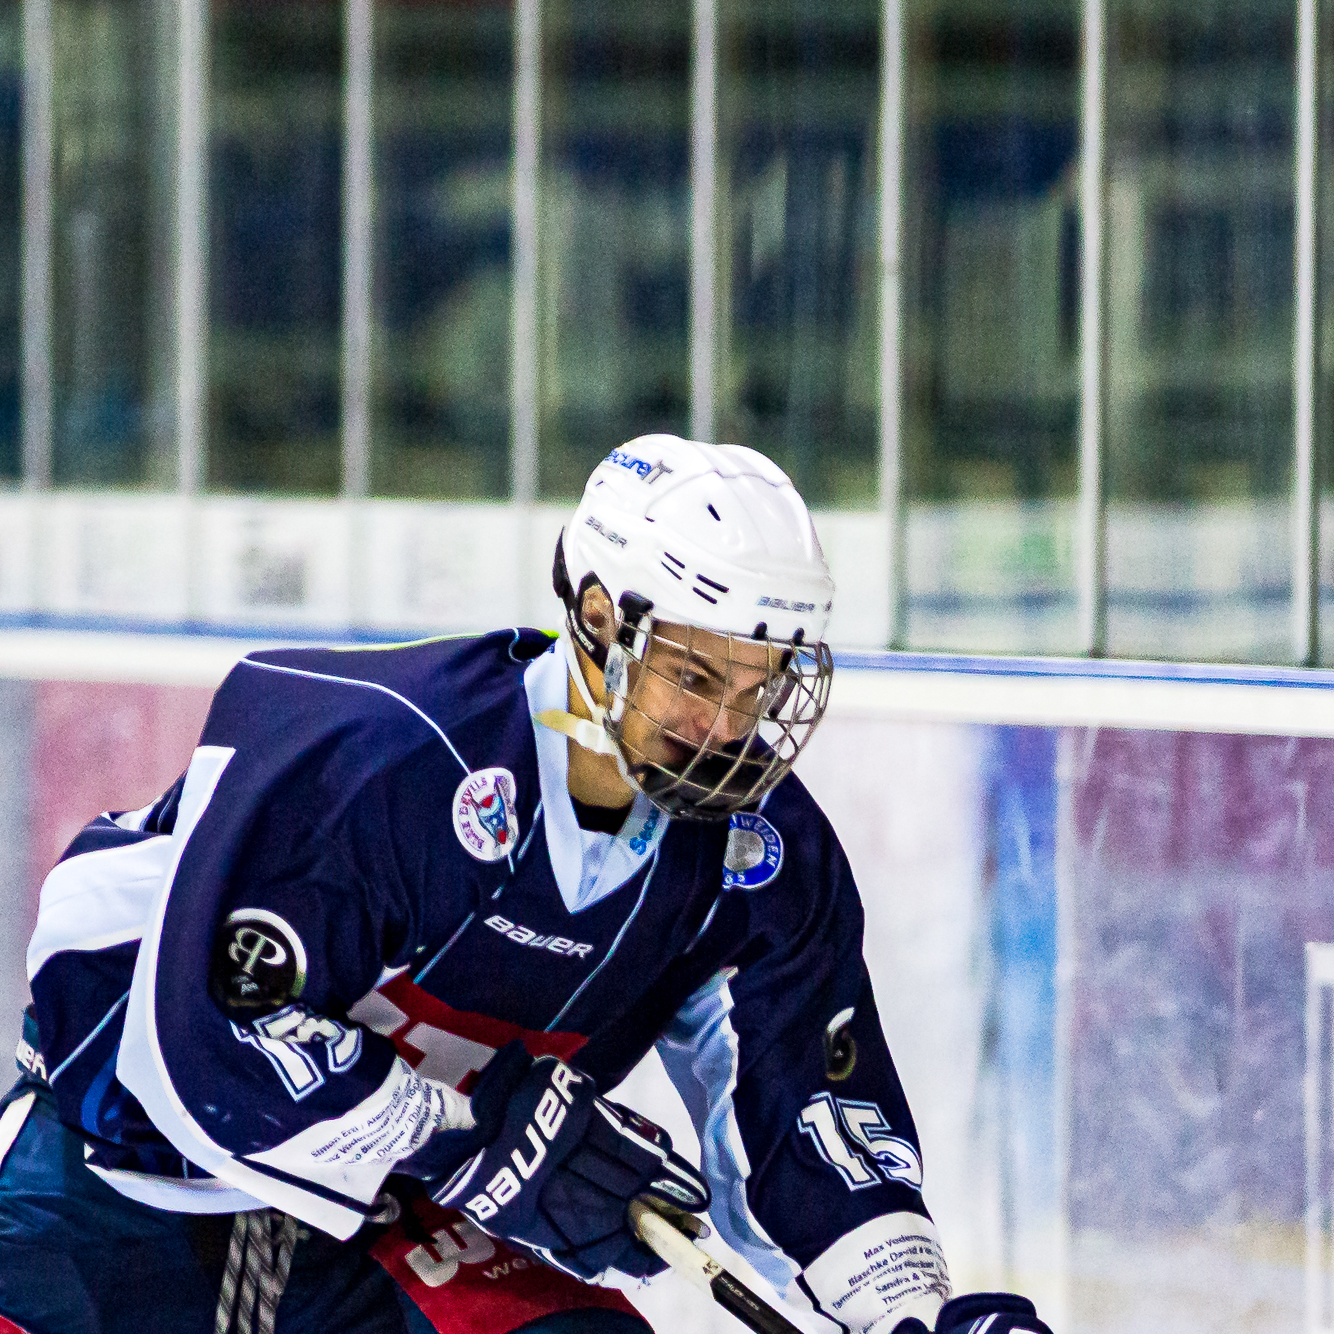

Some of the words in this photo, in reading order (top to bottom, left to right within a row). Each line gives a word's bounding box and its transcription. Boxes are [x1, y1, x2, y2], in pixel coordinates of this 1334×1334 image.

[740, 815, 779, 869] WEIDEN
[484, 914, 594, 959] BAUER
[465, 1061, 582, 1221] BAUER
[797, 1091, 924, 1191] 15
